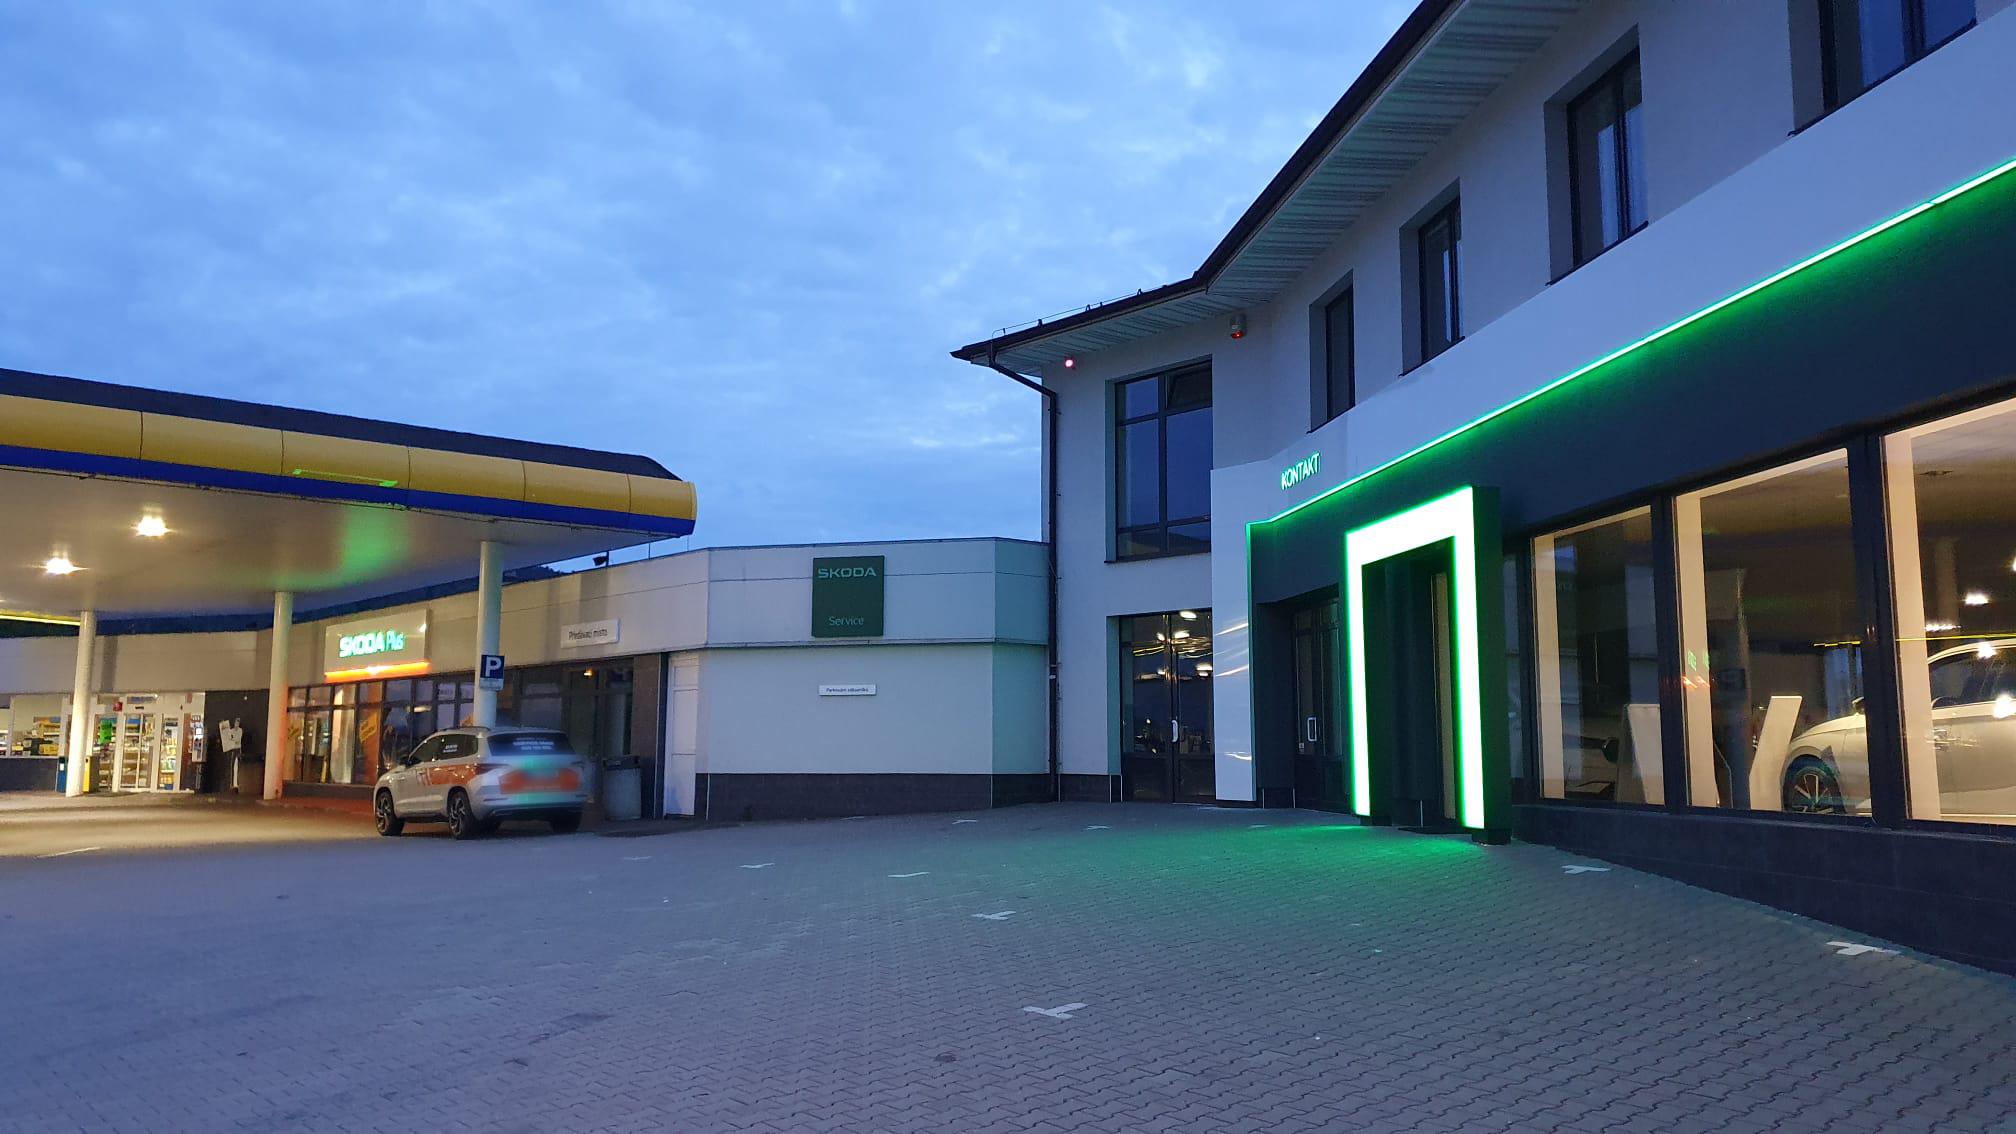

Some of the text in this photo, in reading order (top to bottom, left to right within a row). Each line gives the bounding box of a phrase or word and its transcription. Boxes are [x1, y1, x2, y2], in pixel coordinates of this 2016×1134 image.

[1281, 452, 1320, 490] KONTAKT
[828, 616, 865, 626] Service
[485, 656, 502, 677] P
